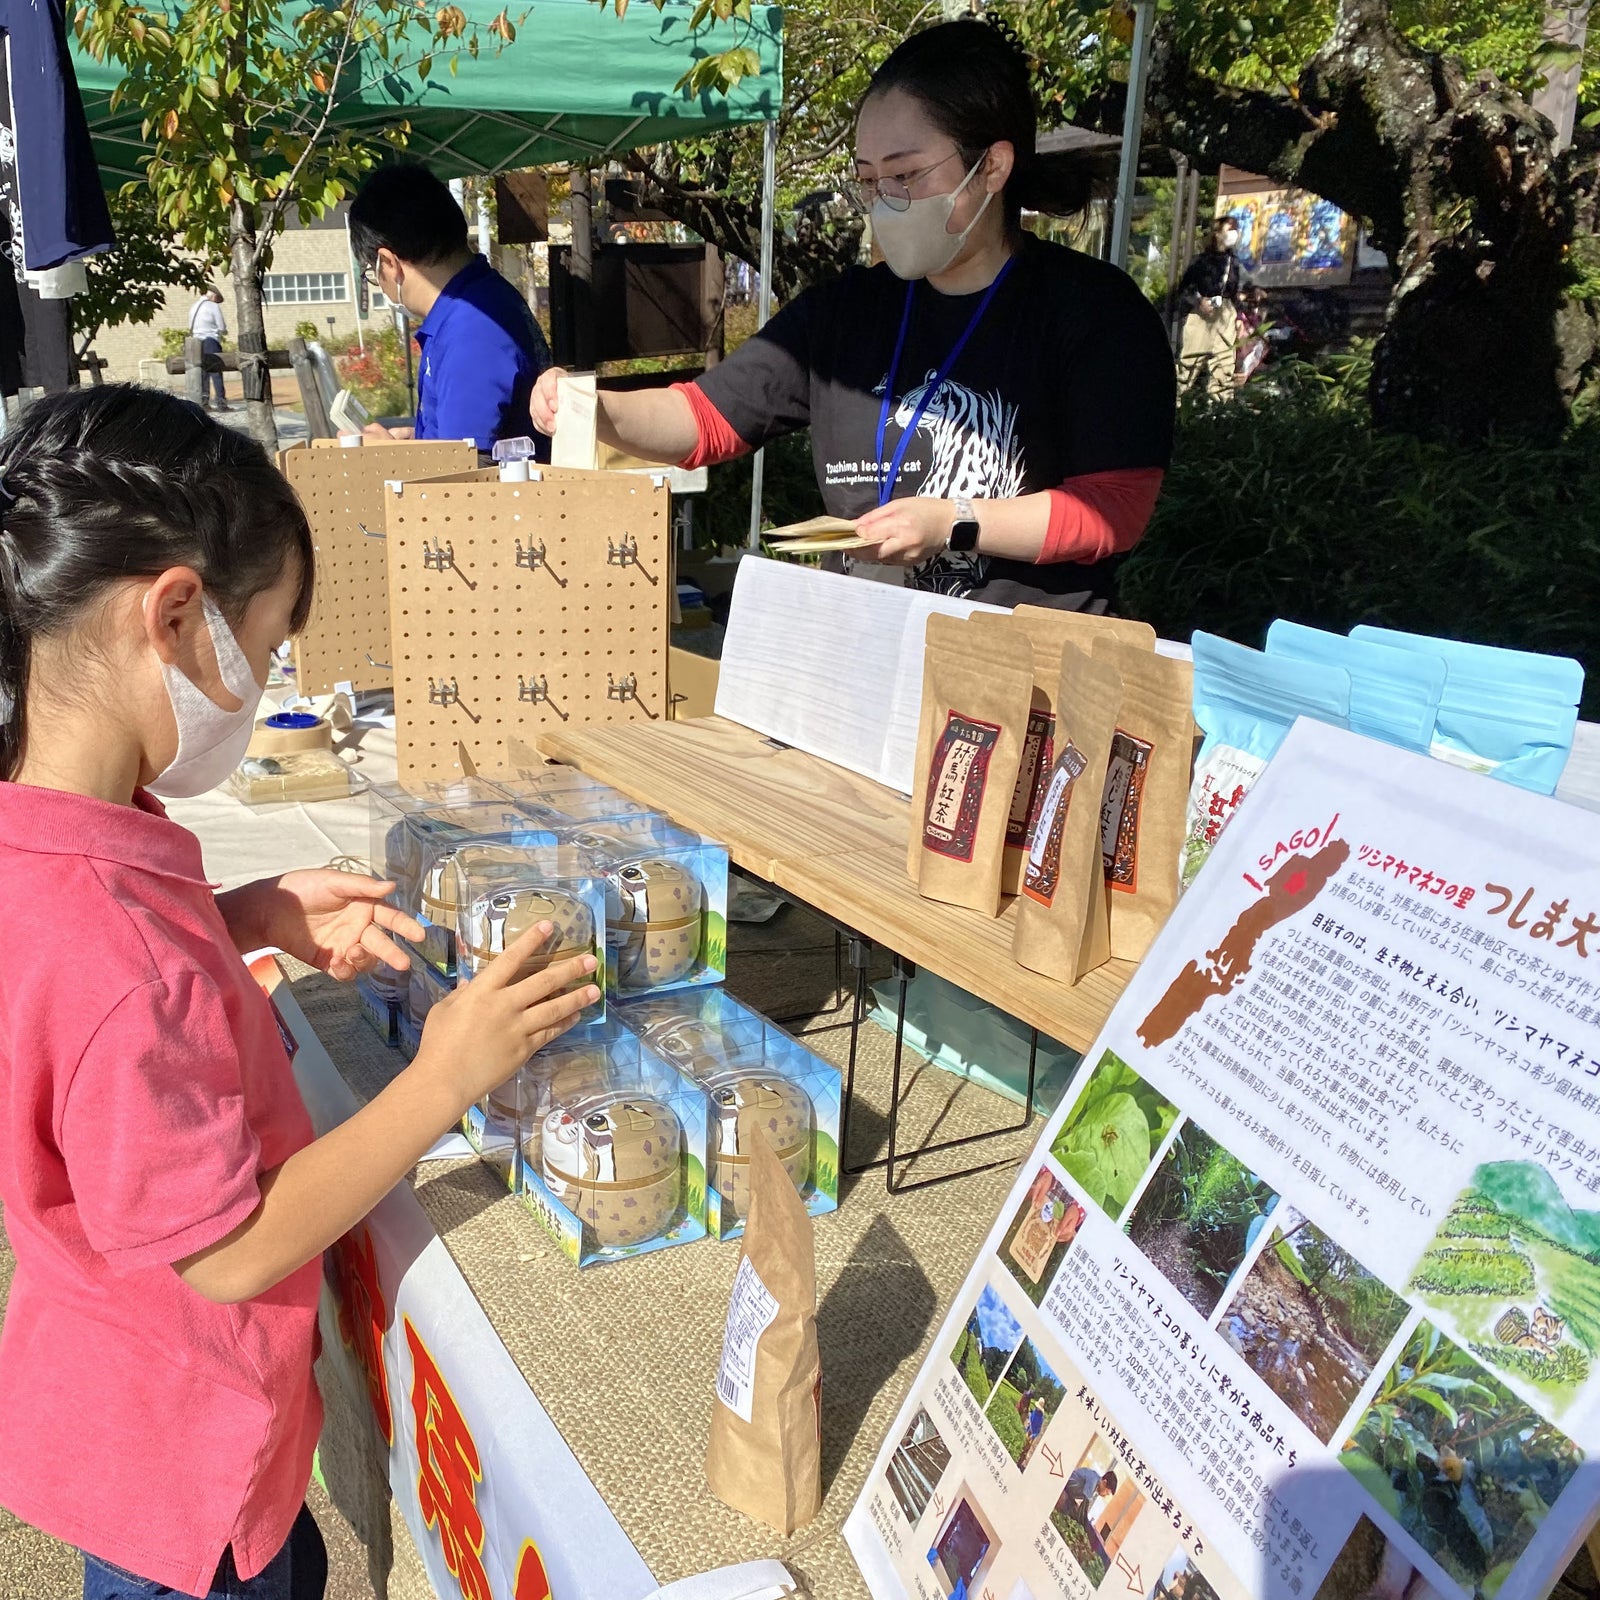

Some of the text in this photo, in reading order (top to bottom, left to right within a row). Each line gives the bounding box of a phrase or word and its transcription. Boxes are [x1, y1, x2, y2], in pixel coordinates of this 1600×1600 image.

[903, 460, 921, 471] cat
[932, 743, 968, 825] 対馬紅茶
[1258, 827, 1321, 872] SAGO
[1358, 844, 1476, 910] ツシマヤマネコの里
[1485, 882, 1600, 958] つしま大
[1173, 1039, 1198, 1065] ません。
[1202, 1012, 1388, 1155] 生き物に支えられて、当園のお茶は出来ています。
[1218, 1004, 1388, 1132] とっては下草を刈ってくれる大事な仲間です。
[1248, 982, 1419, 1104] 害虫はいつの間にか少なくなっていました。
[1258, 951, 1600, 1168] 代表がスギ林を切り拓いて造ったお茶畑は、環境が変わったことで害虫が
[1164, 1053, 1370, 1225] ツシマヤマネコも暮らせるお茶畑作りを目指しています。
[1044, 1297, 1101, 1376] 品も開発しています。
[1110, 1256, 1300, 1469] ツシマヤマネコの暮らしに繋がる商品たち
[1075, 1385, 1207, 1556] 美味しい対馬紅茶が出来るまで
